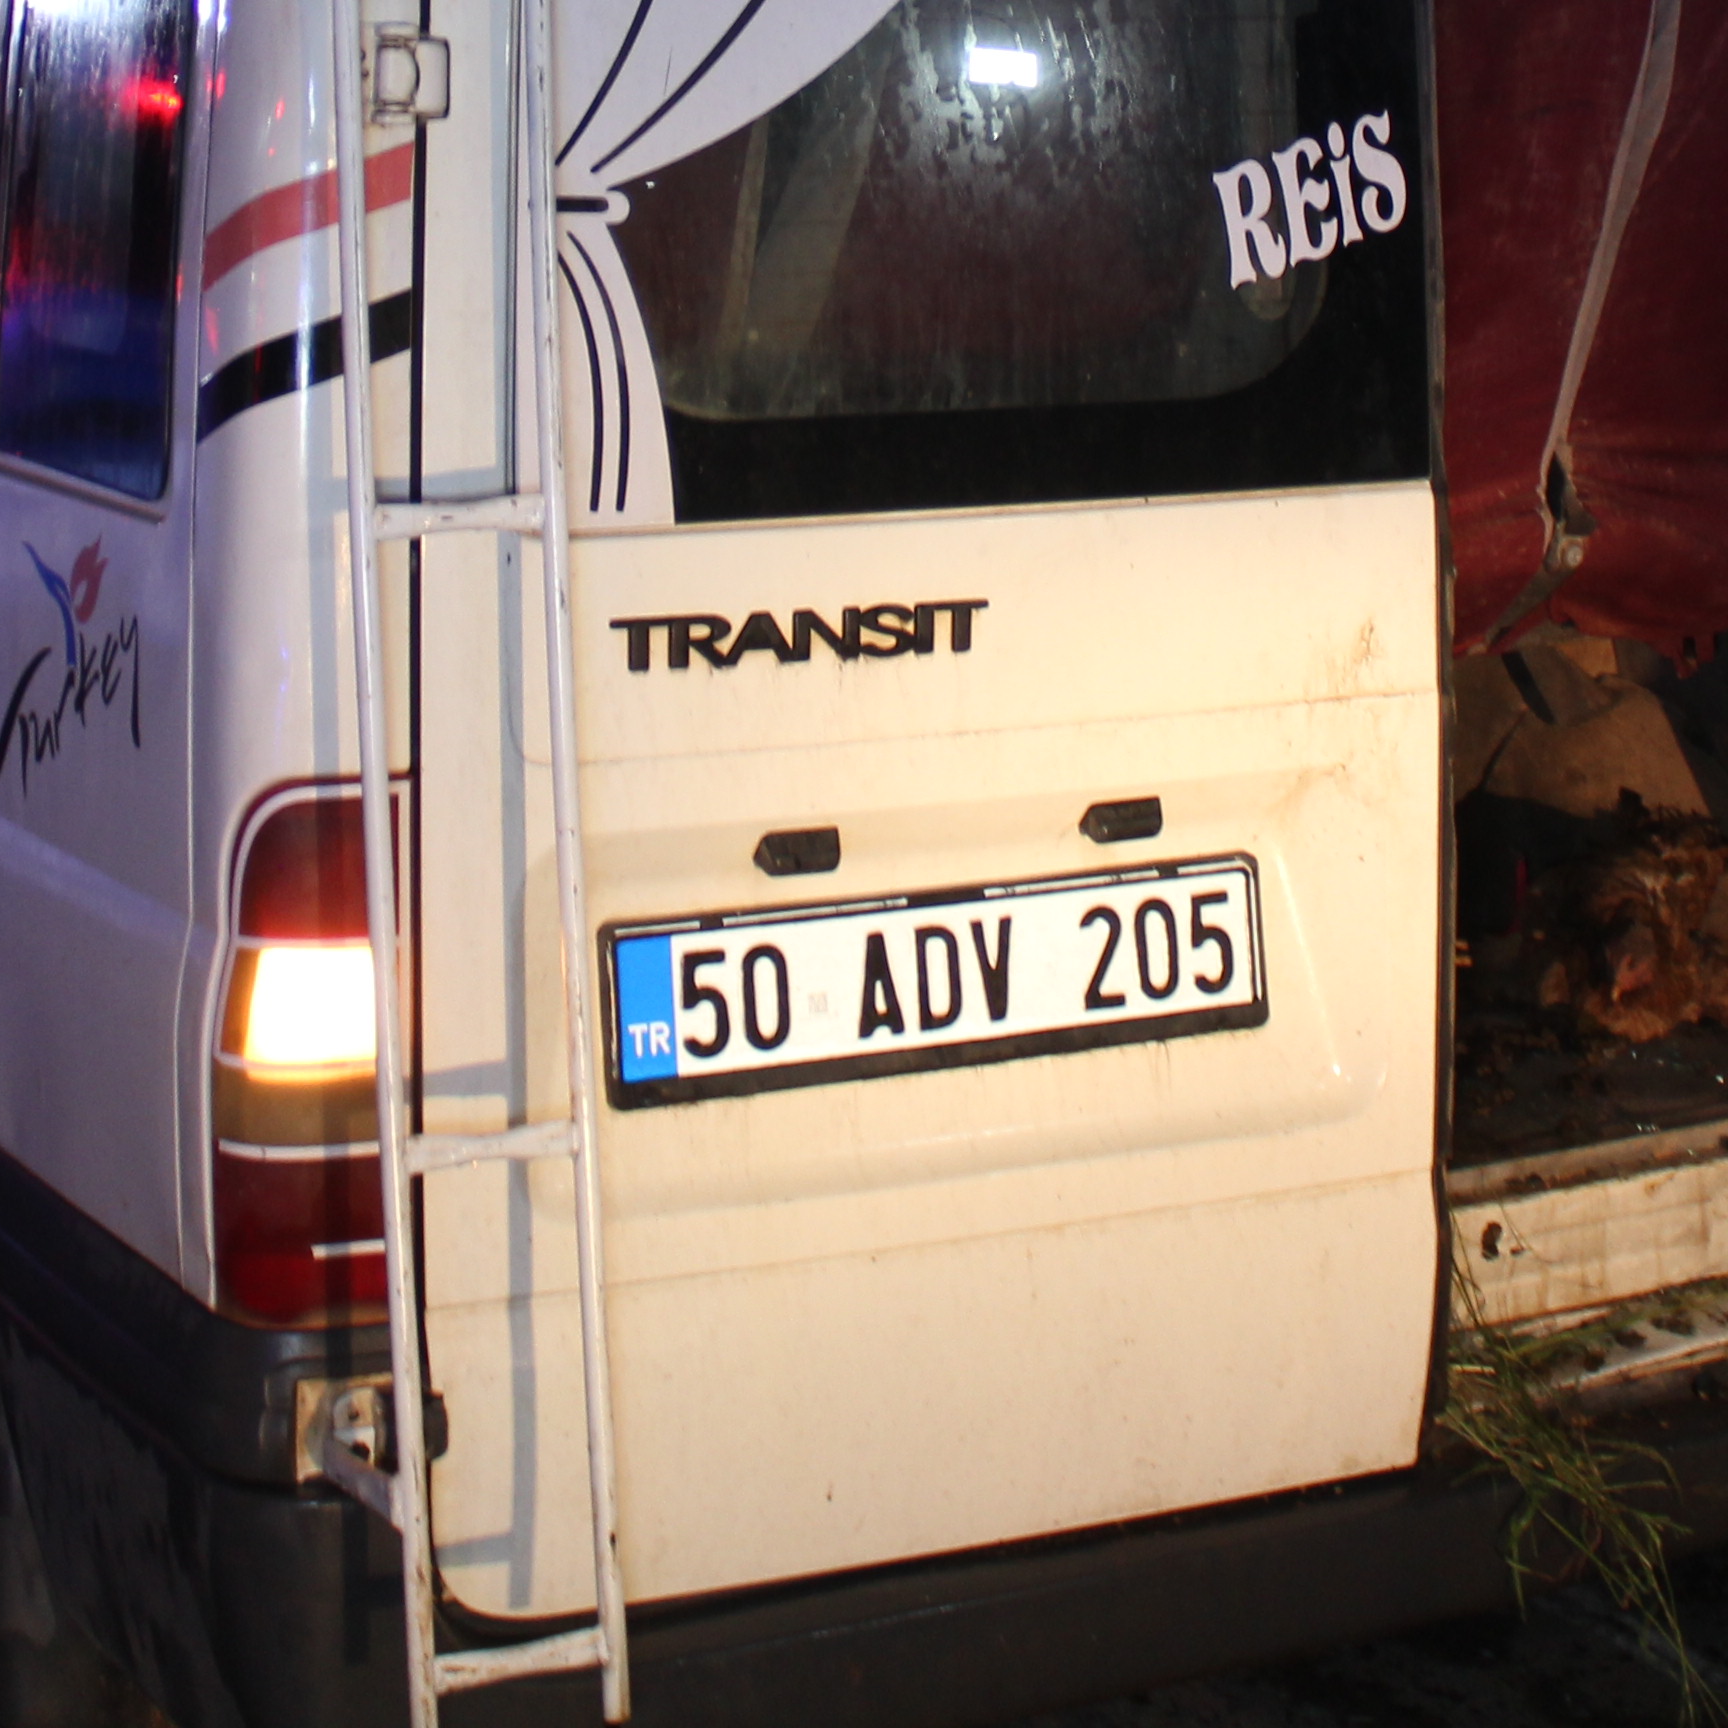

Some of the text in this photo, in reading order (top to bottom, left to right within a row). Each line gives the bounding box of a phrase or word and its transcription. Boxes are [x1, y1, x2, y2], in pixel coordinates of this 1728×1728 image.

[609, 598, 989, 672] TRANSIT
[628, 890, 1234, 1059] TR 50 ADV 205
